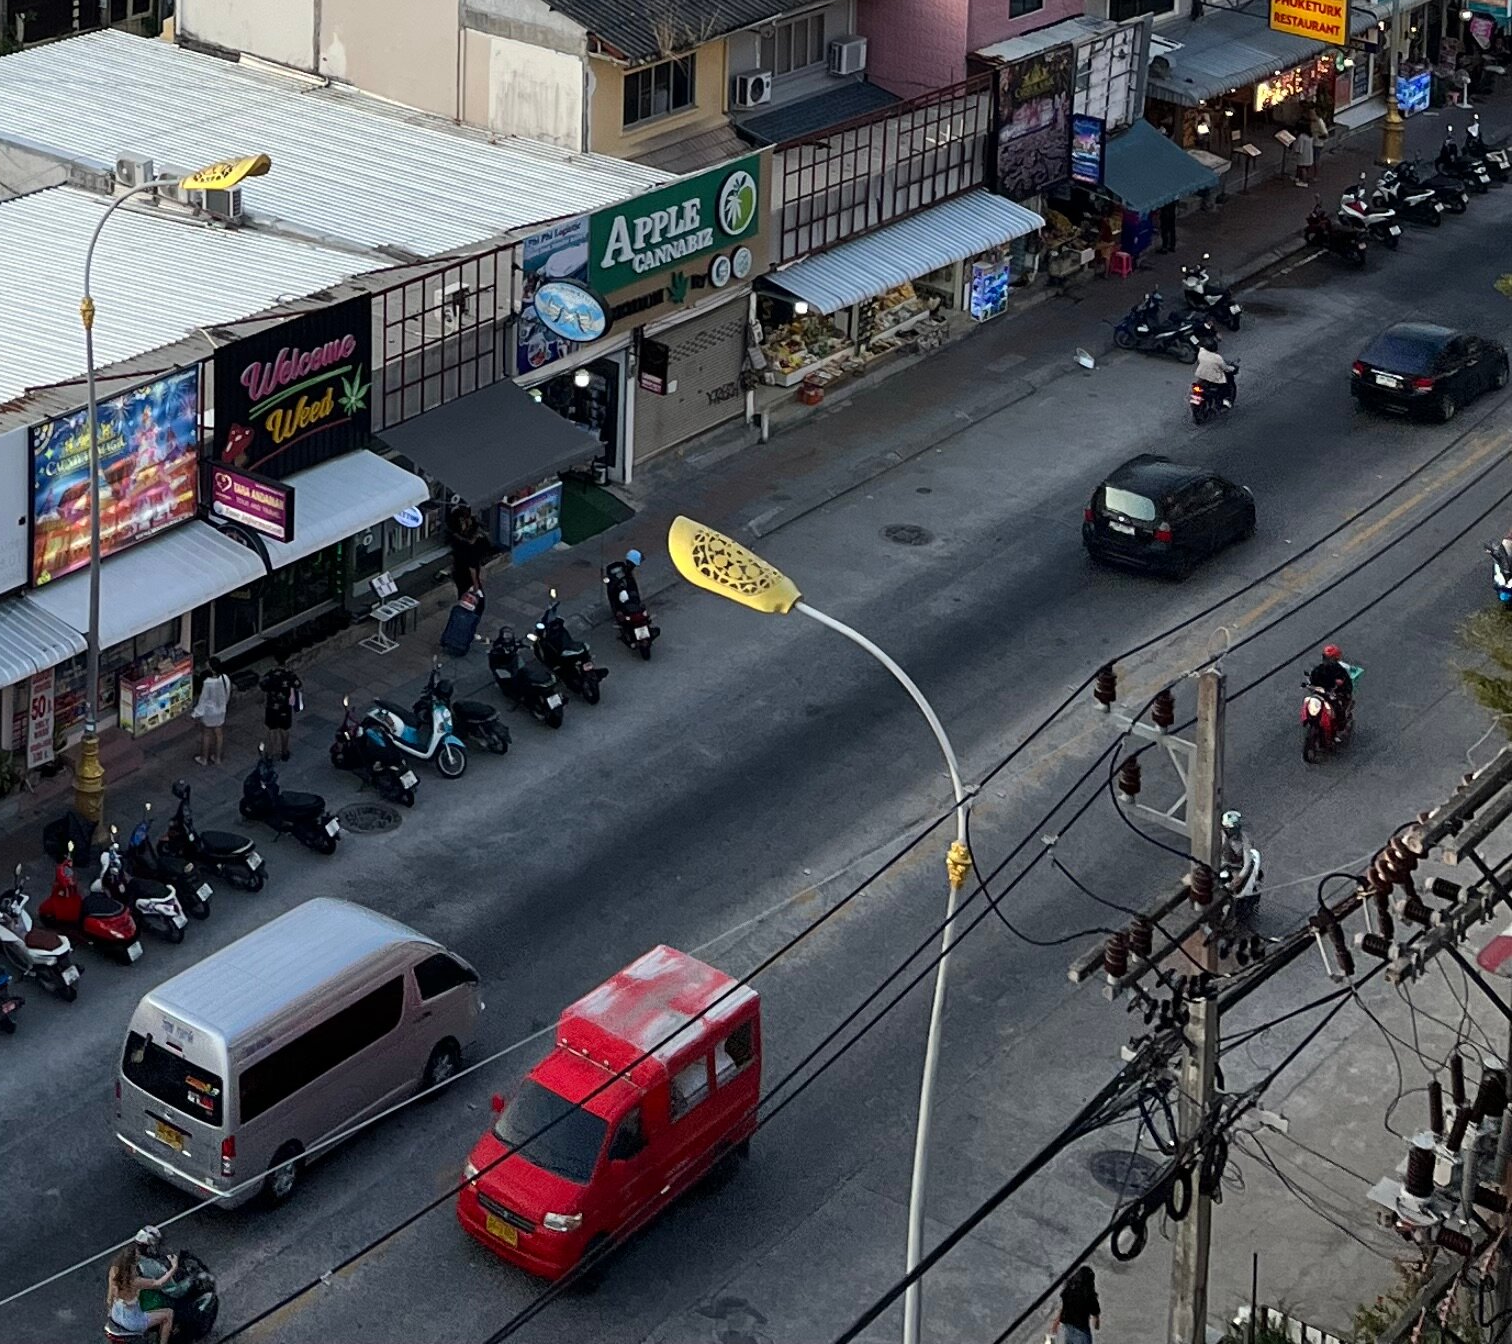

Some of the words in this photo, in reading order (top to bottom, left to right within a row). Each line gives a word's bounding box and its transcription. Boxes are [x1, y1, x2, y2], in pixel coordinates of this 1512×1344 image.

[1273, 11, 1341, 37] RESTAURANT
[600, 197, 701, 269] APPLE
[632, 227, 714, 274] CANNABIZ
[239, 333, 357, 401] Welcome
[265, 386, 335, 444] Weed
